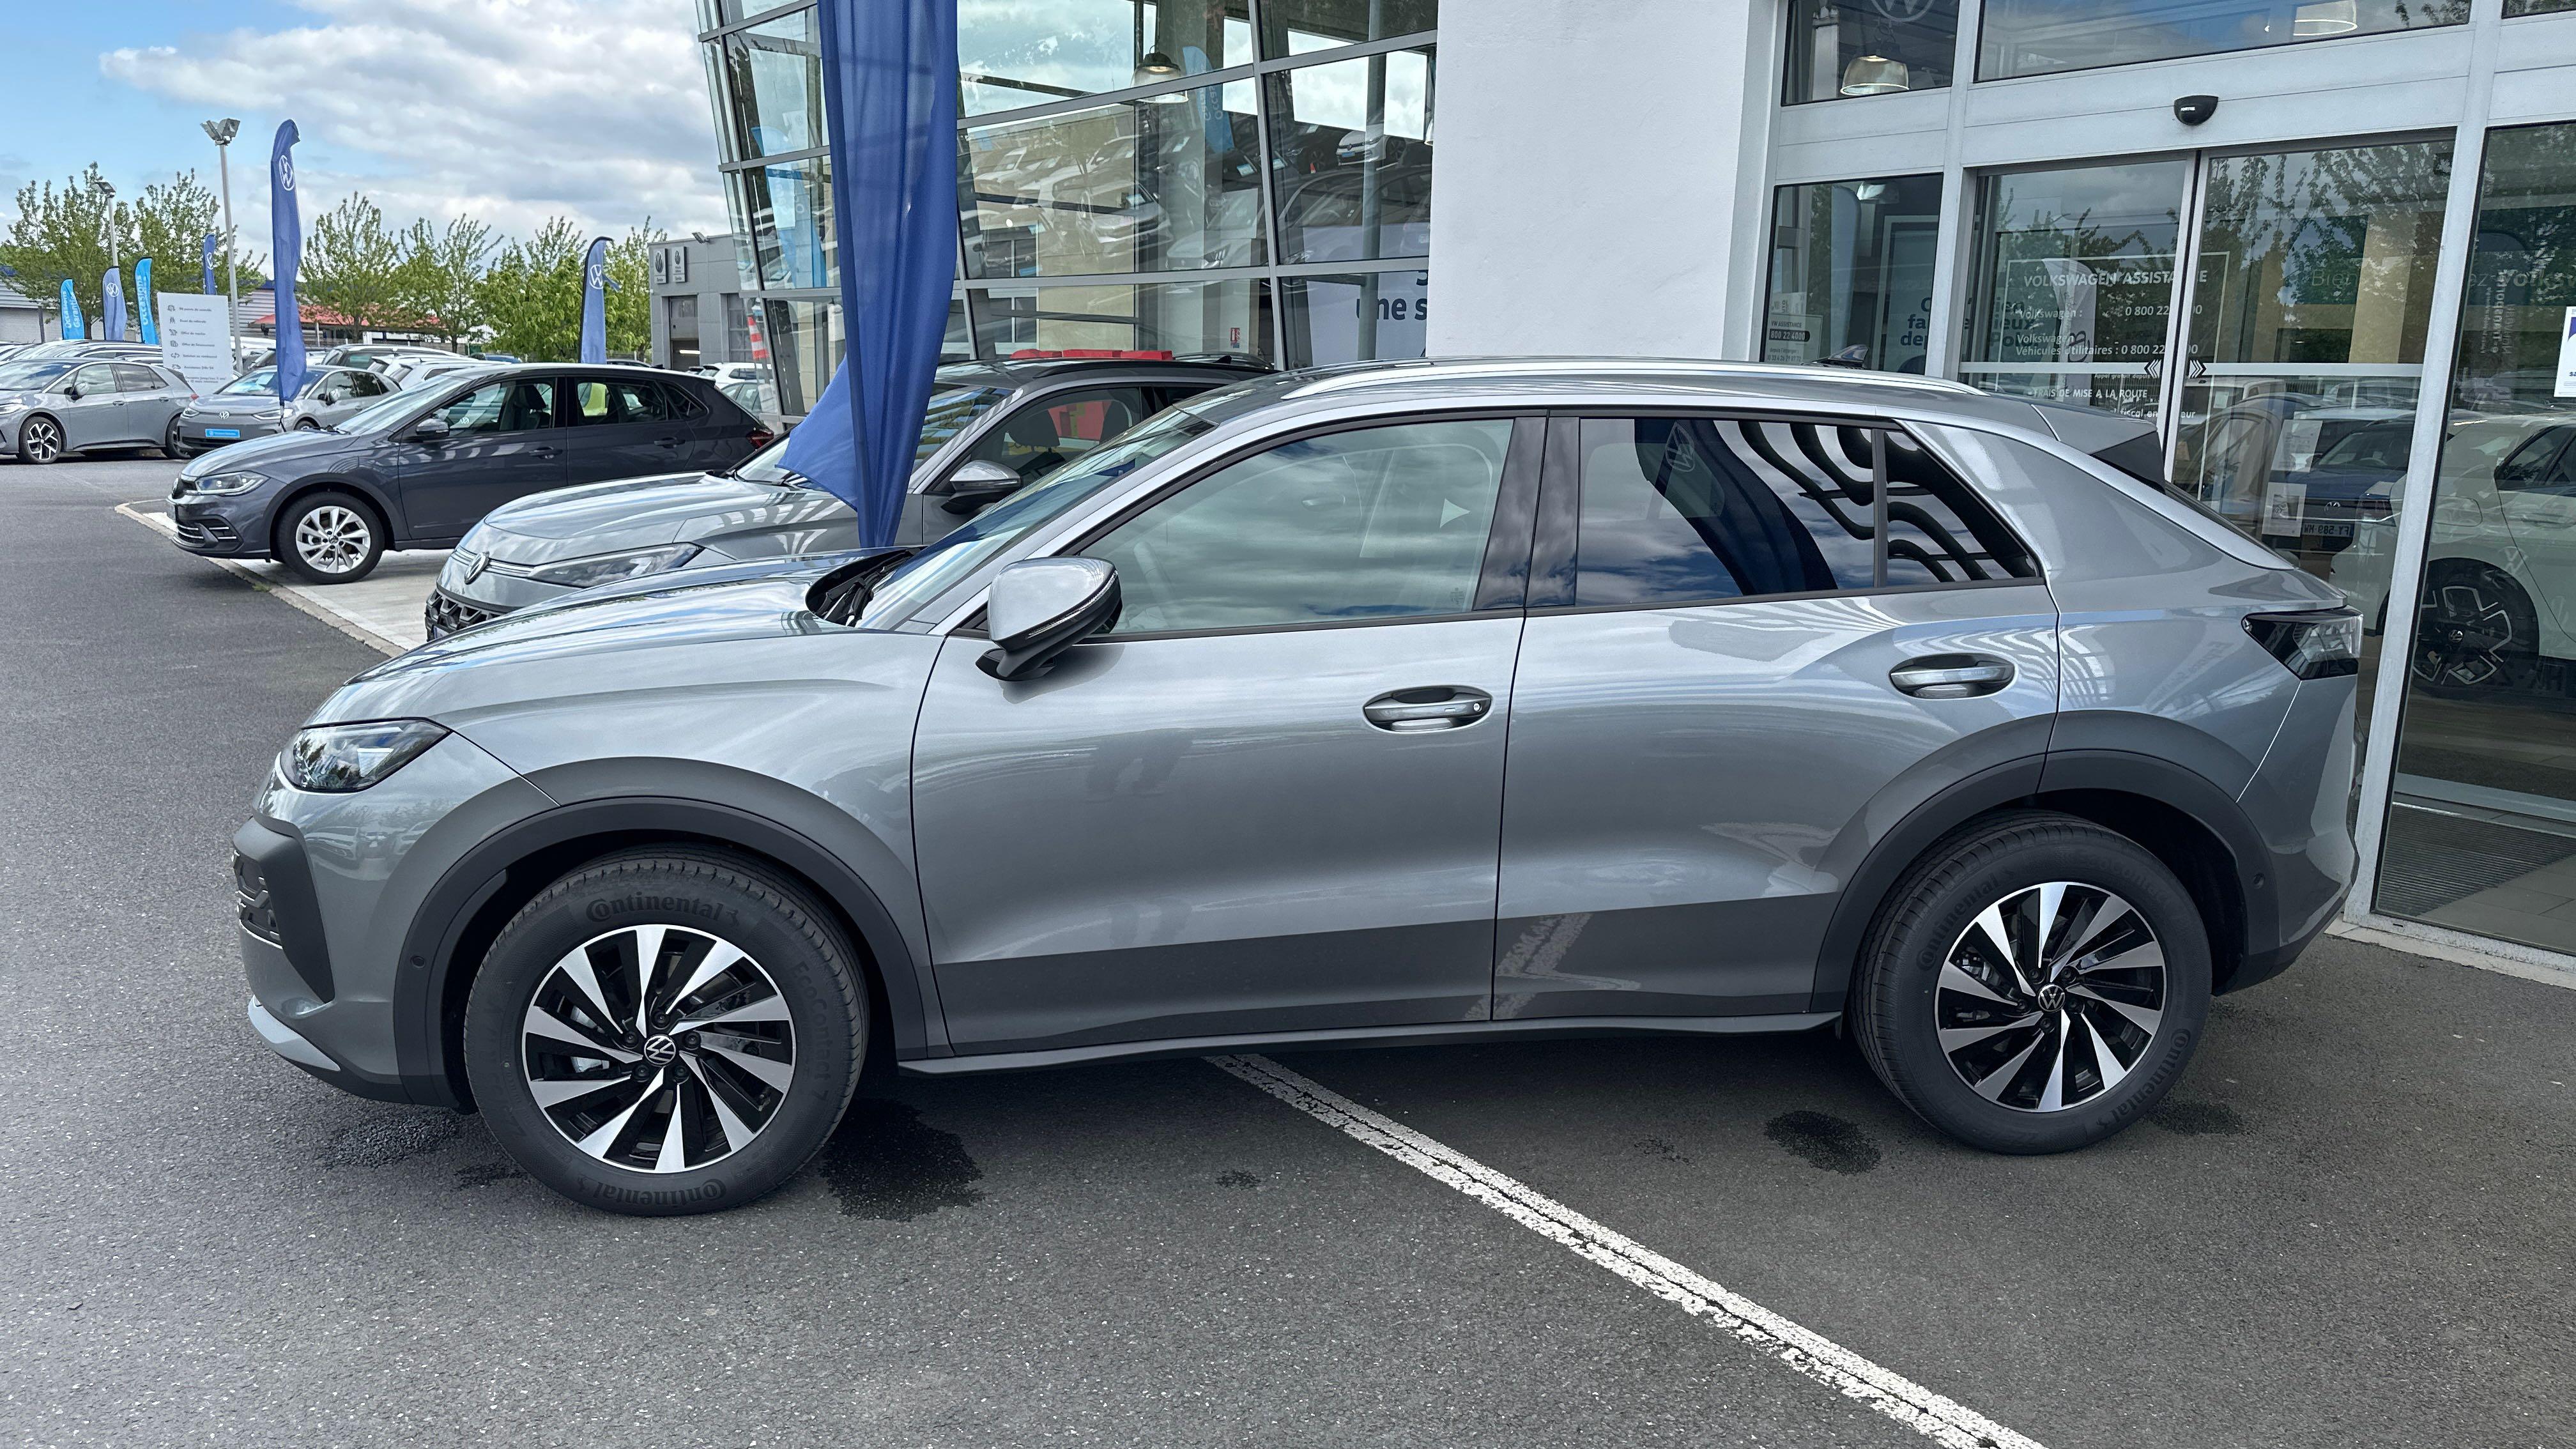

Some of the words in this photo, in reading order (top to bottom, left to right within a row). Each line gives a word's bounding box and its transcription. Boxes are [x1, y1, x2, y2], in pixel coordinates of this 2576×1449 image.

[2135, 306, 2154, 316] 800
[1791, 332, 1805, 341] 4000
[2017, 334, 2074, 345] Volkswagen
[2016, 345, 2060, 355] Véhicules
[2130, 345, 2149, 354] 800
[2058, 389, 2070, 397] DE
[2073, 388, 2093, 397] MISE
[2119, 388, 2148, 398] ROUTE
[585, 891, 724, 923] Continental
[2111, 1028, 2191, 1123] Continental
[592, 1178, 727, 1207] Continental
